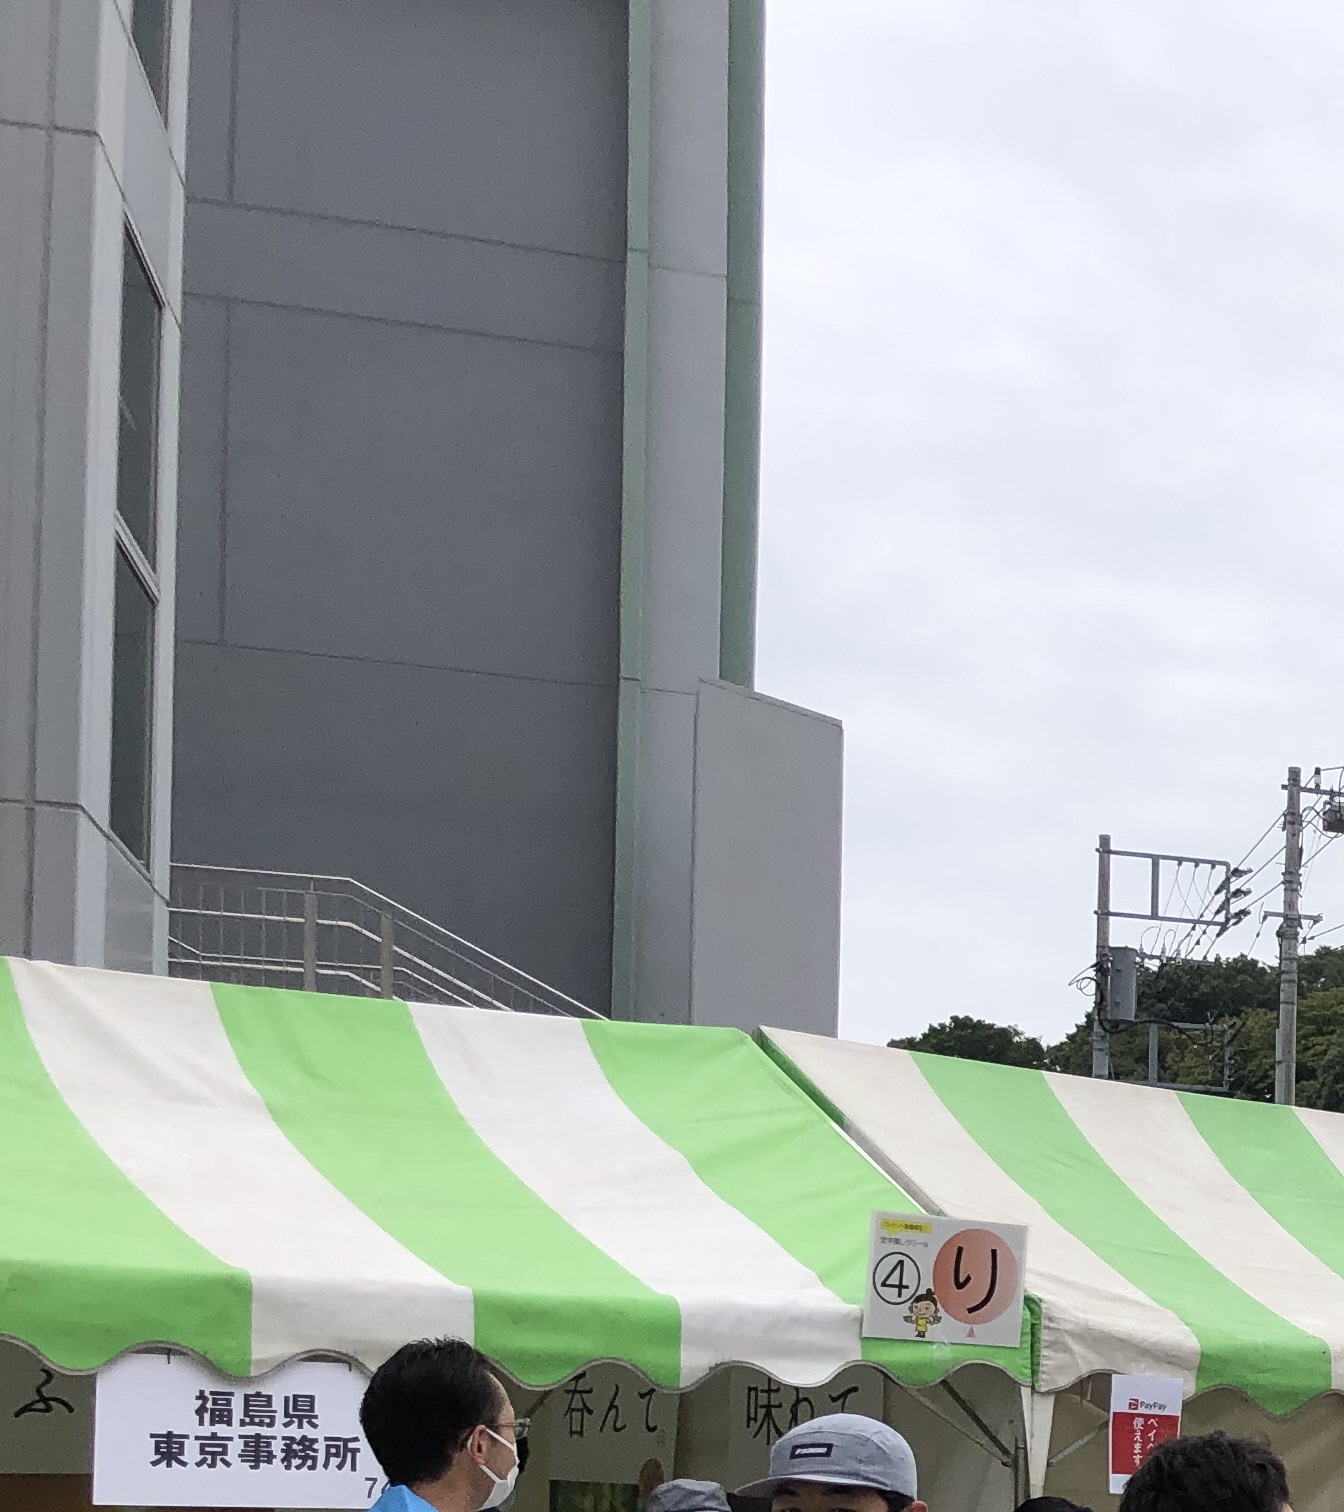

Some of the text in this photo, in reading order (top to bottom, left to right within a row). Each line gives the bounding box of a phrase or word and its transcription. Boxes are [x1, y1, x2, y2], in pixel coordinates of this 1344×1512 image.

[953, 1245, 998, 1315] り
[194, 1389, 319, 1429] 福島県
[1140, 1400, 1167, 1412] PayPay
[149, 1431, 361, 1472] 東京事務所
[1147, 1418, 1159, 1450] ペイペ
